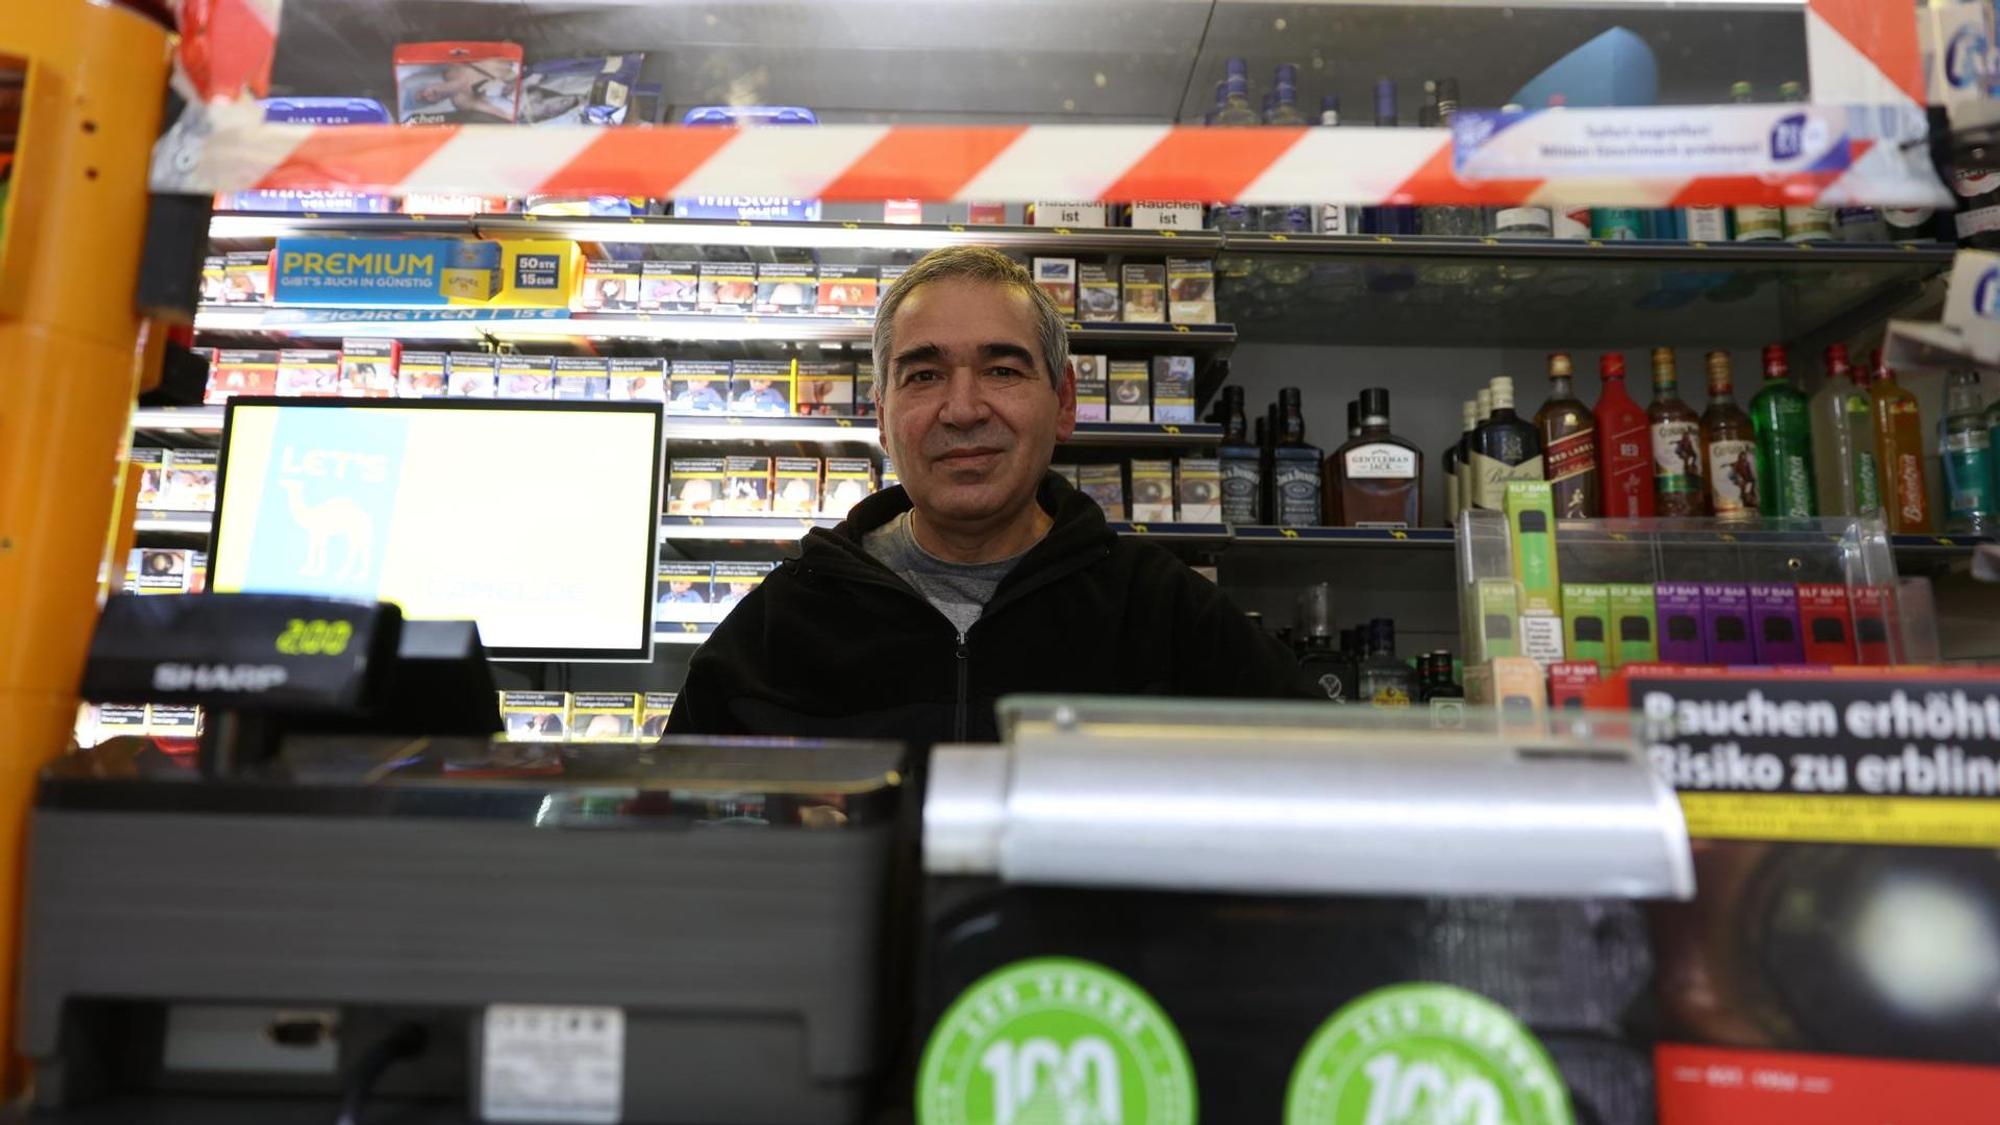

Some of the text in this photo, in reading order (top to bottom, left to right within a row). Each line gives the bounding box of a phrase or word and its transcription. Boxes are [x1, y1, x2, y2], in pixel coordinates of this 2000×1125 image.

[1136, 199, 1200, 210] Rauchen
[1062, 211, 1081, 222] ist
[1159, 213, 1178, 224] ist
[282, 252, 434, 275] PREMIUM
[519, 257, 556, 269] 50 STK
[280, 275, 433, 288] GIBT'S AUCH IN GÜNSTIG
[520, 274, 554, 285] 15 EUR
[314, 308, 477, 321] ZIGARETTEN
[512, 308, 535, 319] 15
[1620, 443, 1640, 457] RED
[1351, 455, 1410, 464] GENTLEMAN
[1549, 451, 1568, 464] RED
[1566, 586, 1607, 596] ELF BAR
[1610, 586, 1652, 596] ELF BAR
[1656, 586, 1700, 596] ELF BAR
[1703, 586, 1747, 596] ELF BAR
[1751, 587, 1794, 597] ELF BAR
[1799, 587, 1845, 597] ELF BAR
[1552, 664, 1598, 675] ELF BAR
[153, 662, 289, 692] SHARP
[1643, 688, 2000, 740] Rauchen erhöht
[1648, 741, 2000, 795] Risiko zu erblin
[979, 1036, 1124, 1125] 100
